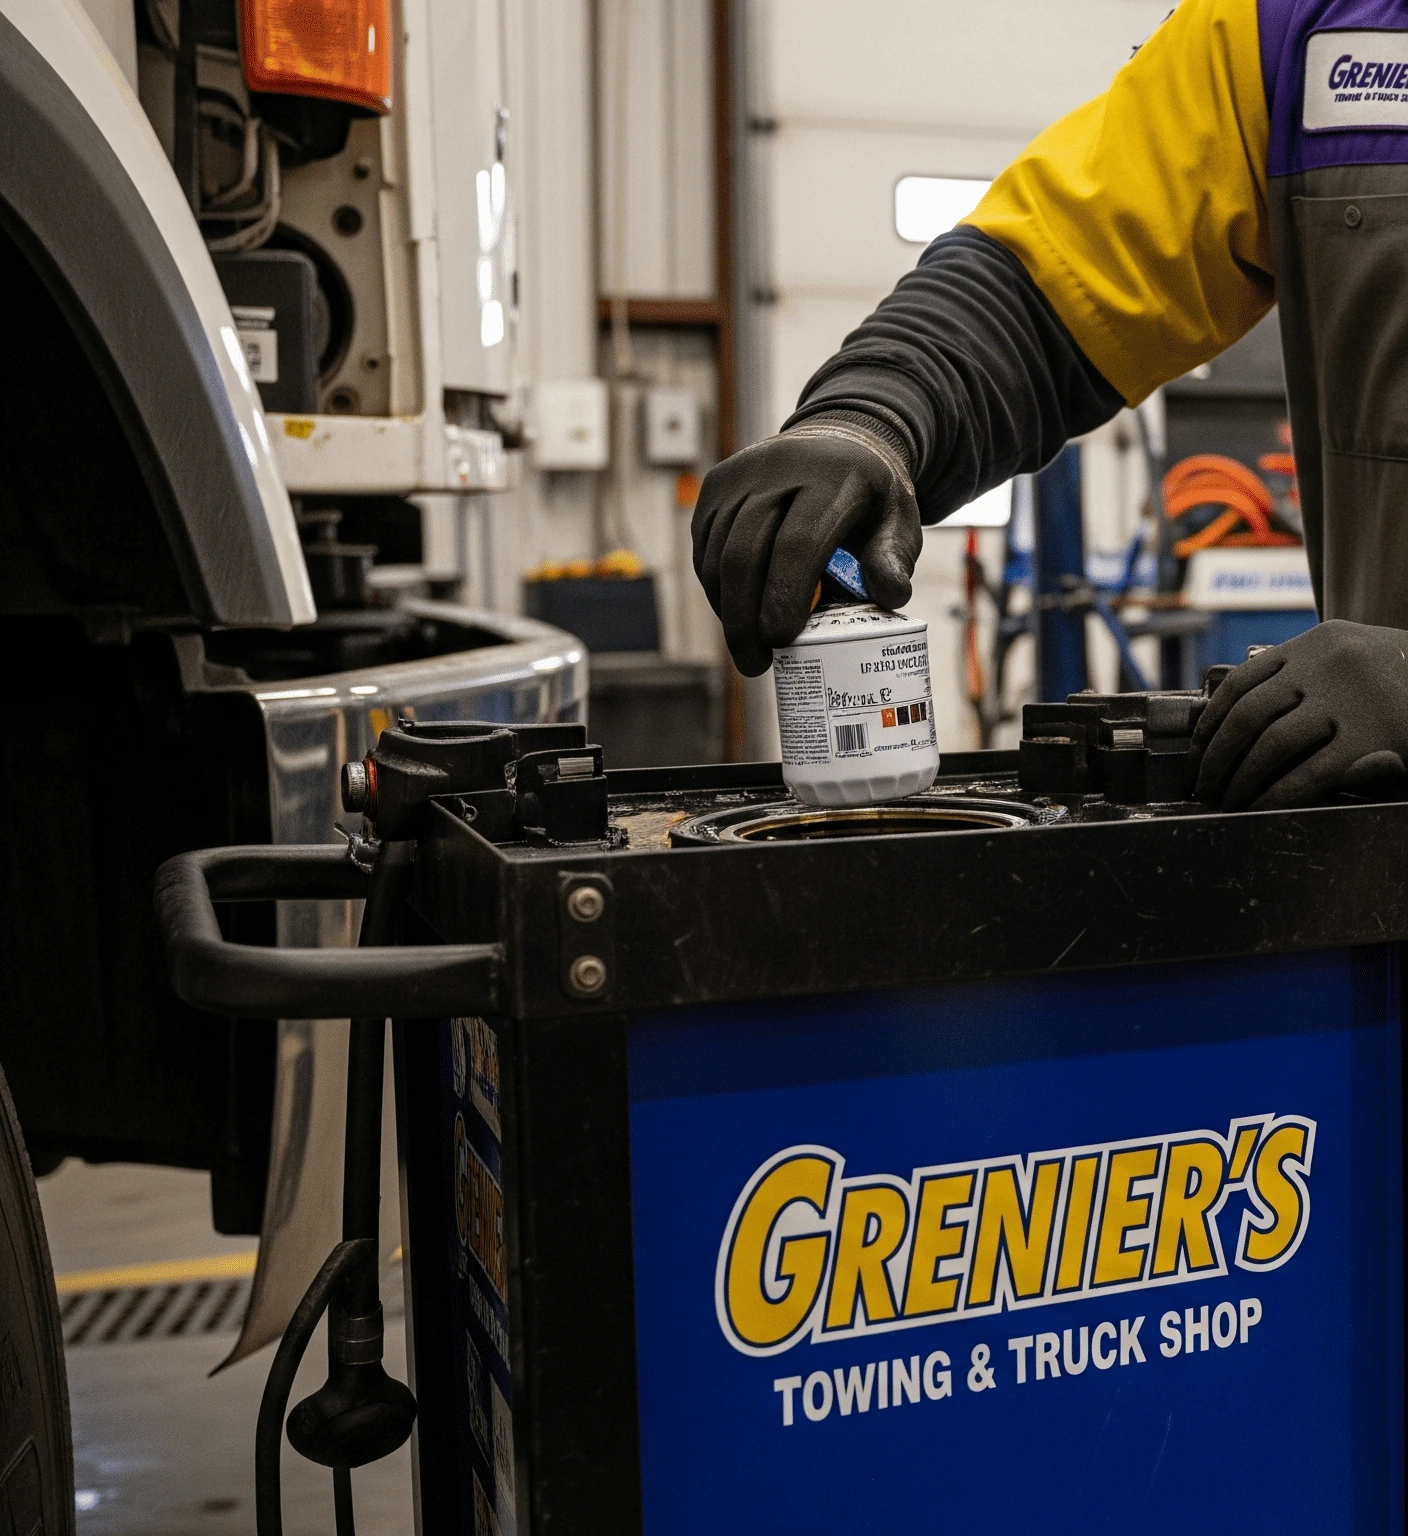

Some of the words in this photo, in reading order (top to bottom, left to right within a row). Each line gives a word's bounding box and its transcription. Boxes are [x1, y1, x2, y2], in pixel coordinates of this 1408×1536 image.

[715, 1113, 1317, 1357] GRENIER'S
[774, 1350, 952, 1426] TOWING
[966, 1343, 996, 1392] &
[1007, 1316, 1147, 1384] TRUCK
[1159, 1298, 1263, 1359] SHOP
